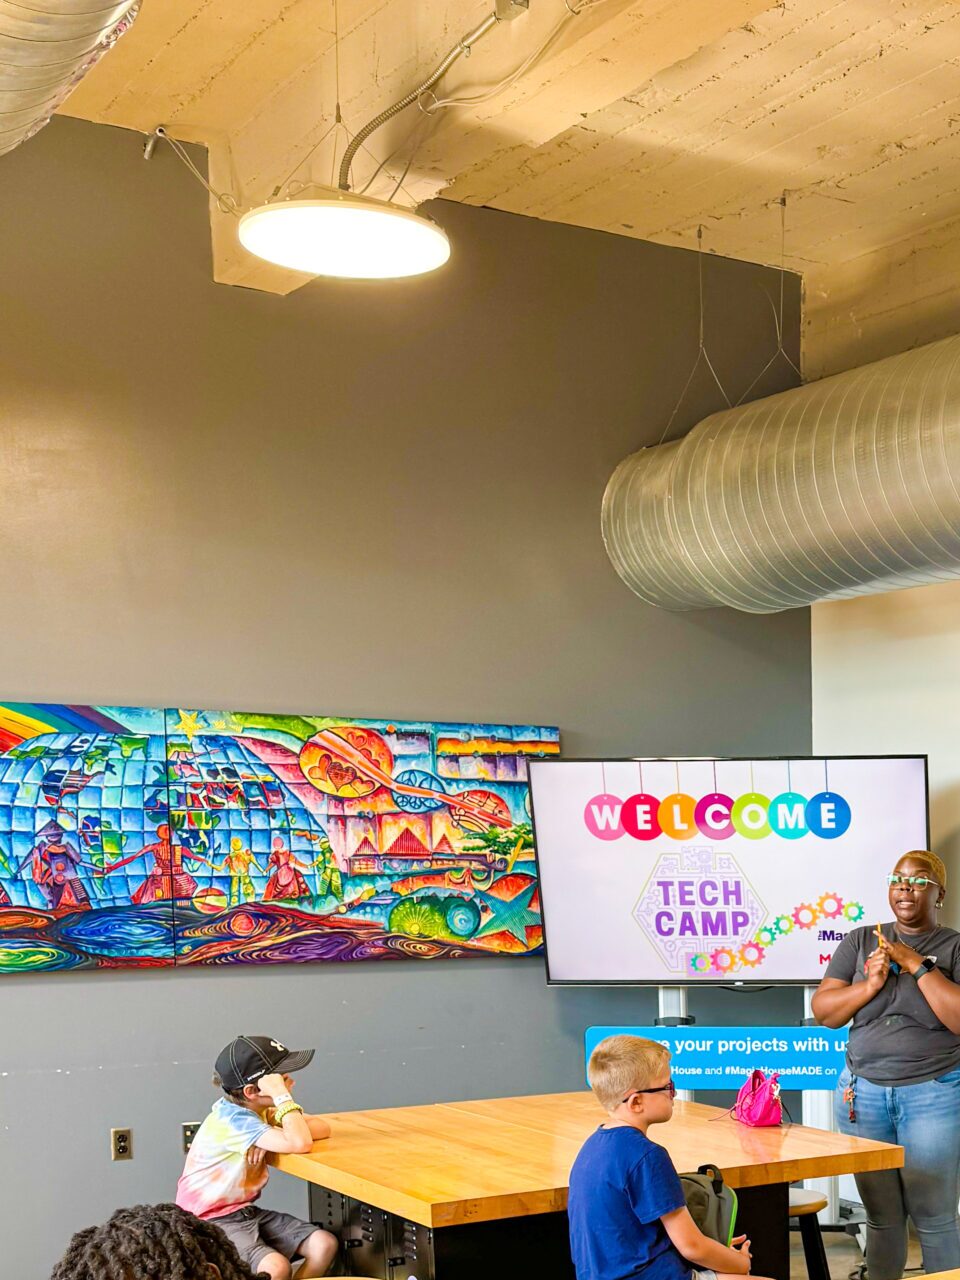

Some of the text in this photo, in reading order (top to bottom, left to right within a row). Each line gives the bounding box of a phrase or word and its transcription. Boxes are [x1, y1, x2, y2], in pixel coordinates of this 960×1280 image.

[591, 803, 836, 830] WELCOME
[657, 881, 741, 906] TECH
[655, 911, 749, 937] CAMP
[675, 1040, 713, 1054] your
[718, 1037, 788, 1054] projects
[793, 1037, 829, 1051] with
[705, 1066, 723, 1075] and
[725, 1066, 823, 1077] #MagiHouseMADE
[825, 1067, 837, 1075] on
